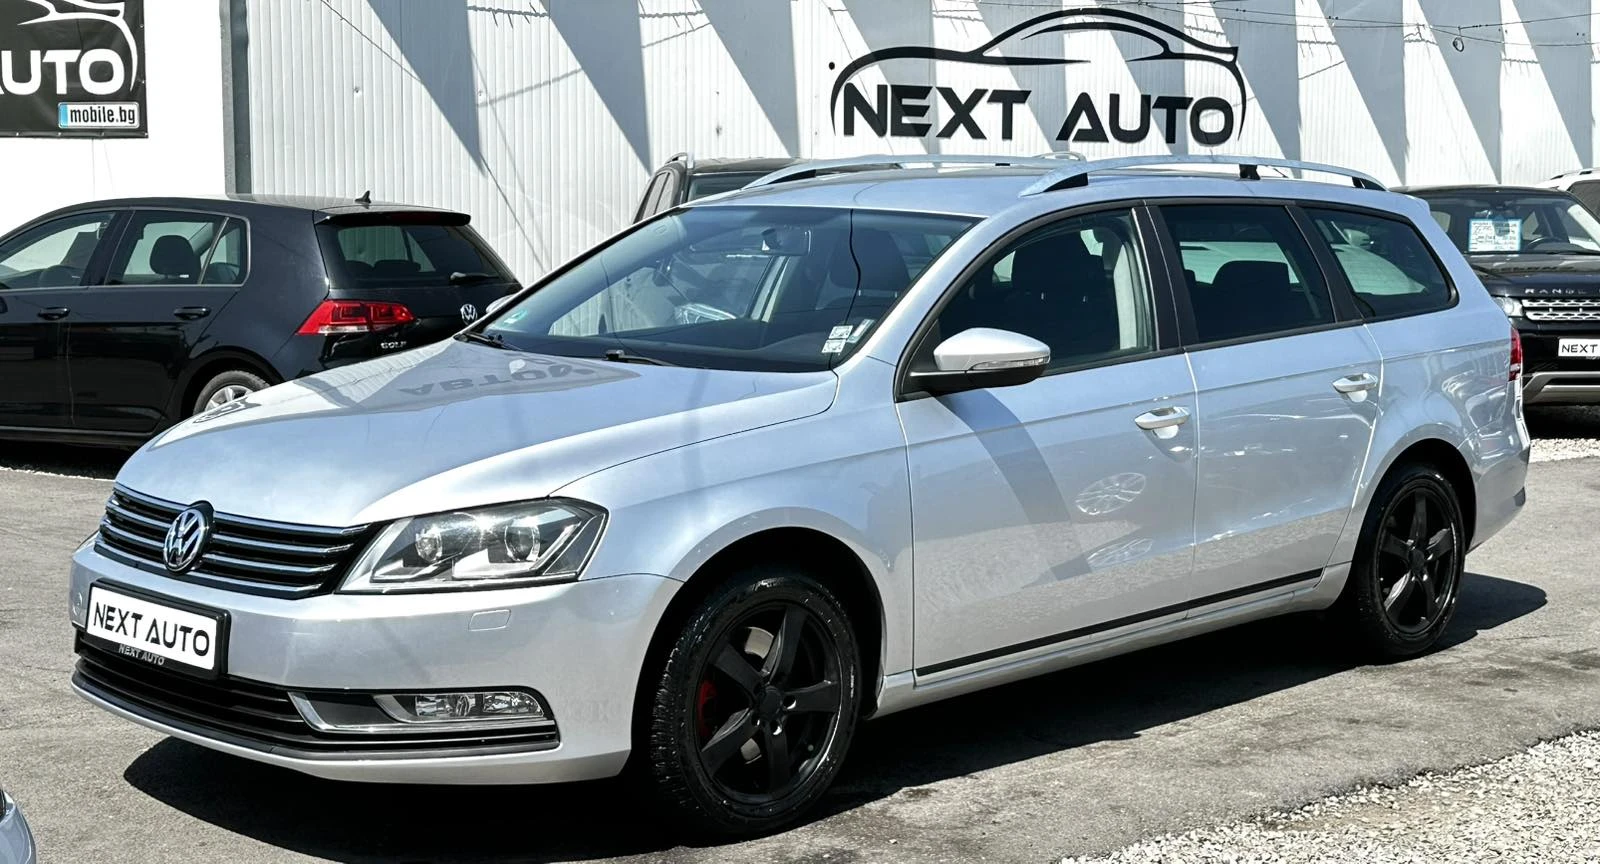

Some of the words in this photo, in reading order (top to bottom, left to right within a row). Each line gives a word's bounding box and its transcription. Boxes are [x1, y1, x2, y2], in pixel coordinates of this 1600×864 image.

[0, 48, 125, 95] UTO
[70, 106, 136, 124] mobile.bg
[843, 82, 1031, 140] NEXT
[1056, 92, 1234, 145] AUTO
[380, 341, 407, 349] GOLF
[1561, 344, 1599, 353] NEXT
[93, 601, 143, 638] NEXT
[145, 617, 210, 657] AUTO
[118, 643, 141, 658] NEXT
[140, 649, 165, 666] AUTO
